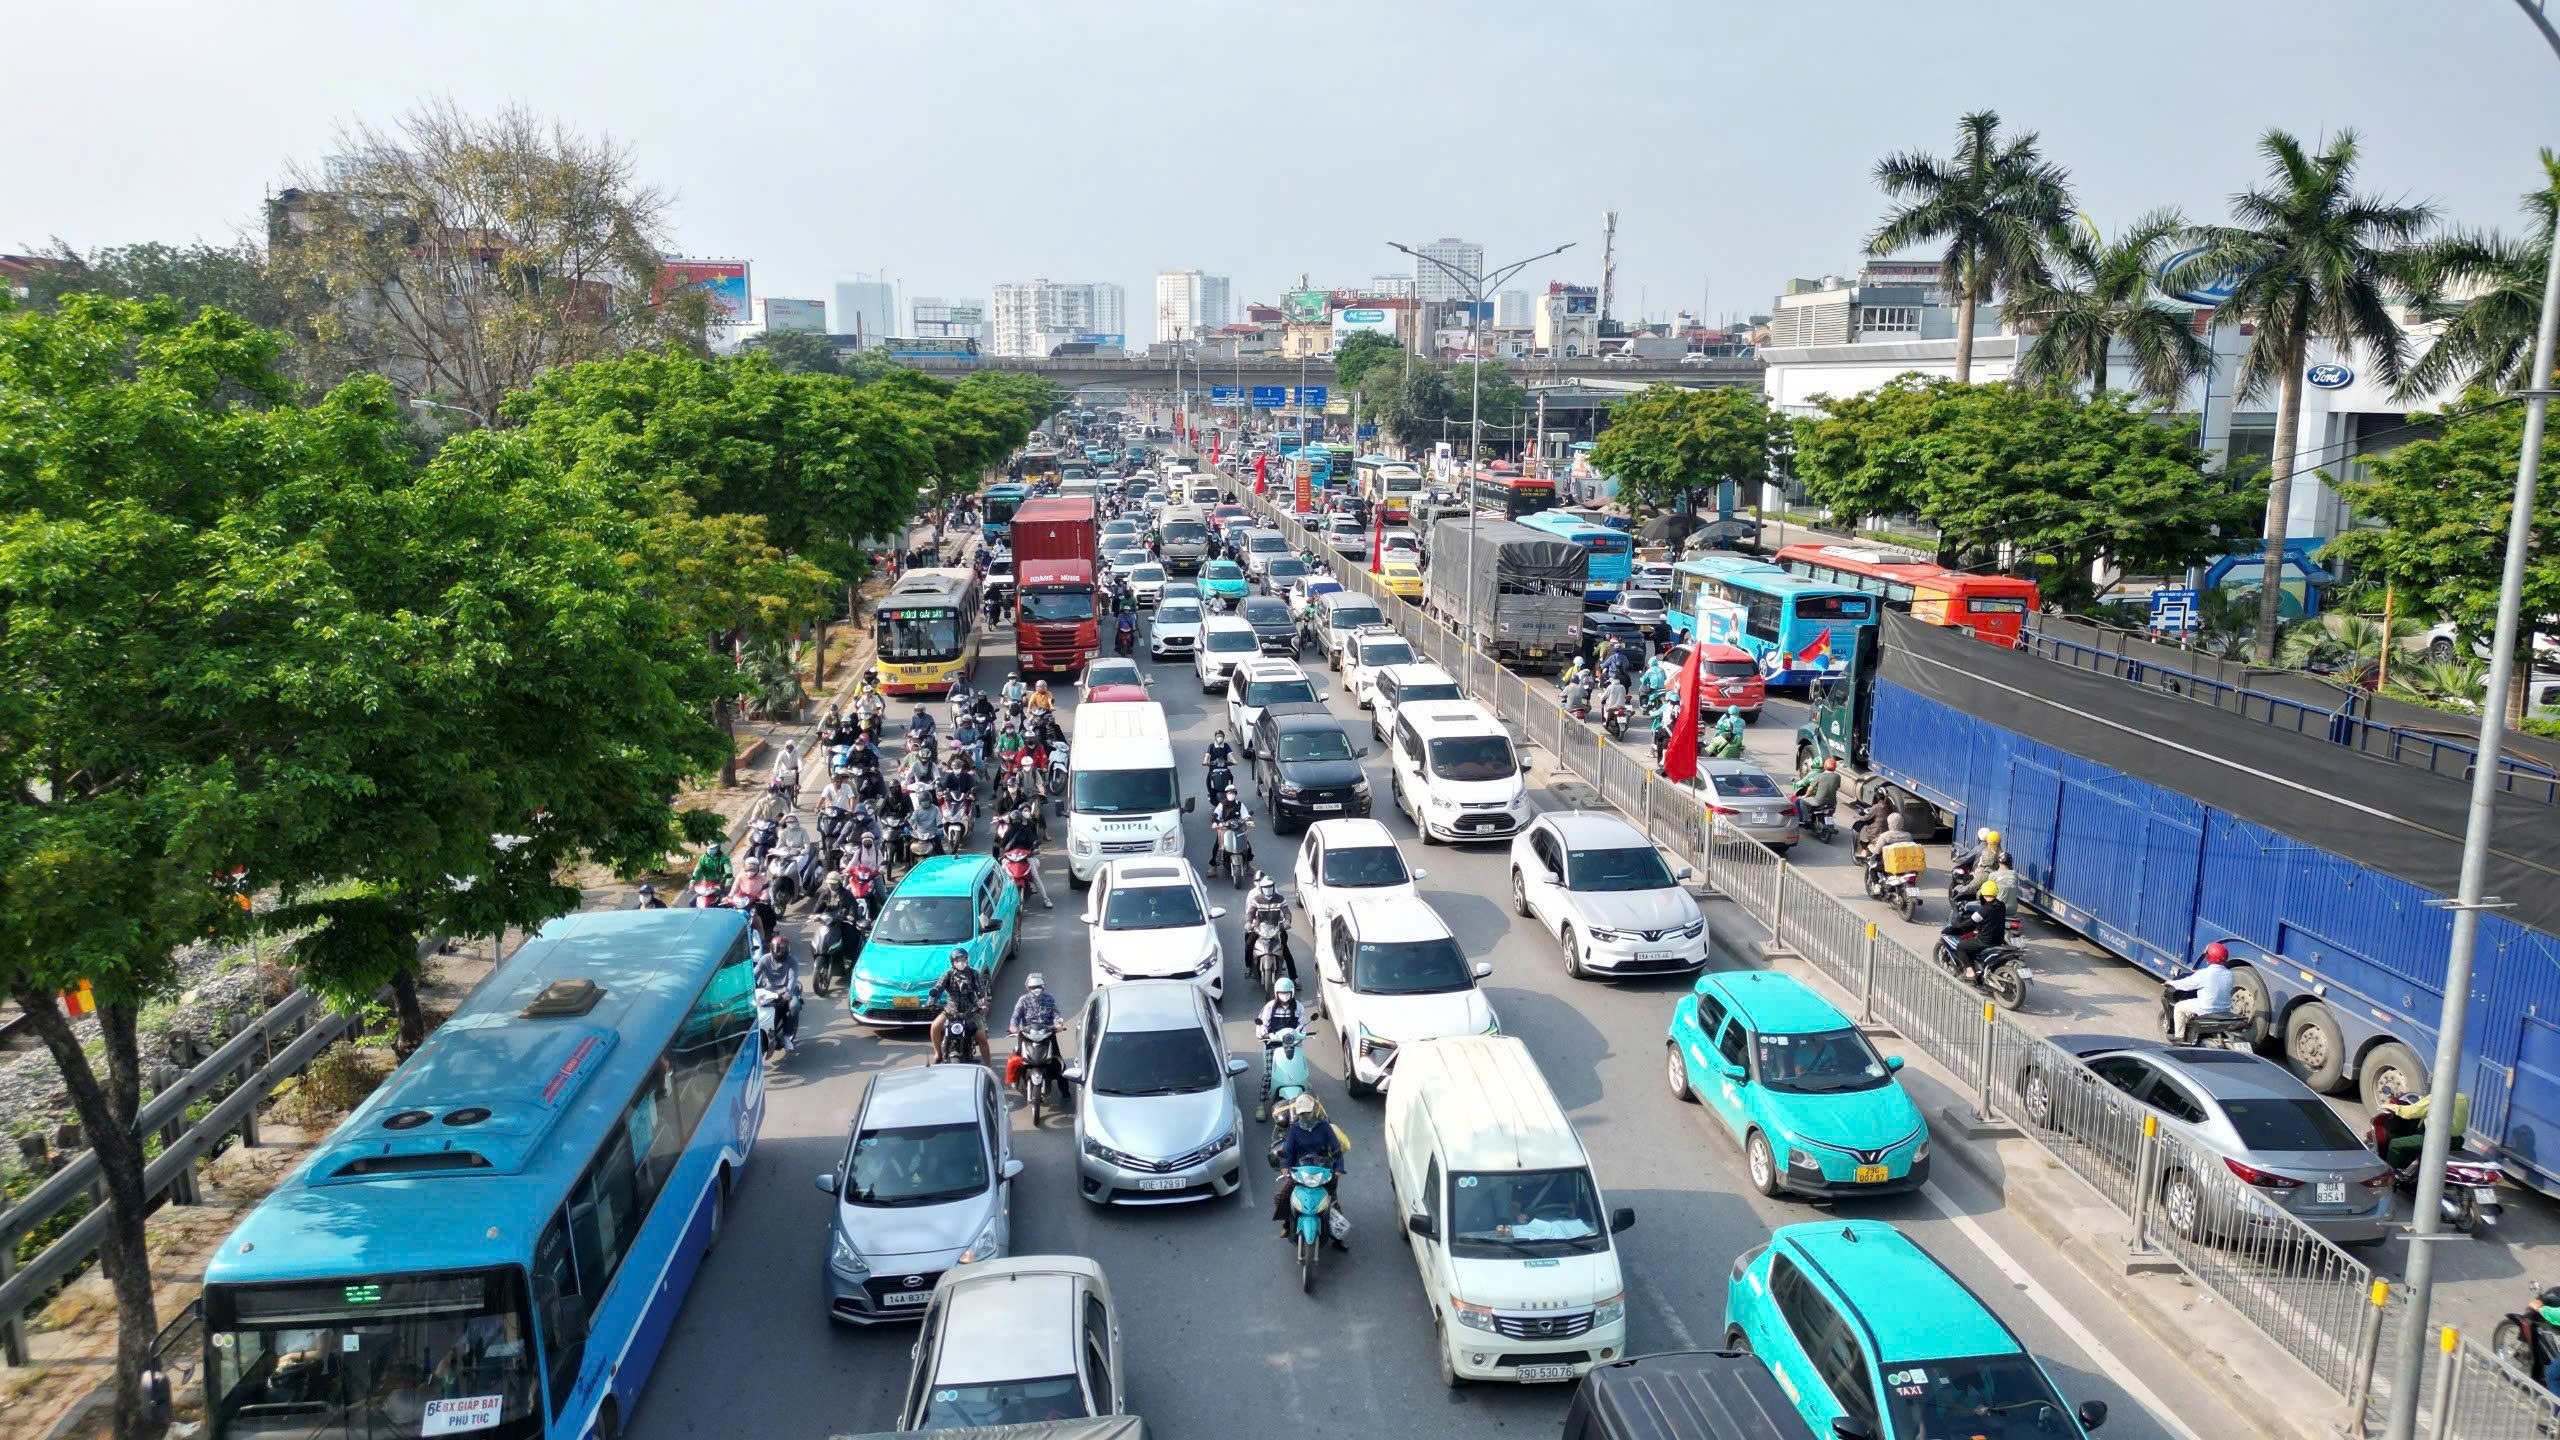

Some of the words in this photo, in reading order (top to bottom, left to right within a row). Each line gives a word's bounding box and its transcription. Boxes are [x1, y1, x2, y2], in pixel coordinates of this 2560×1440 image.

[2312, 367, 2341, 384] Ford
[1092, 823, 1160, 833] VIDIPHA
[2099, 929, 2127, 949] THACO
[2324, 1183, 2338, 1191] 30A
[1896, 1385, 1922, 1396] TAXI
